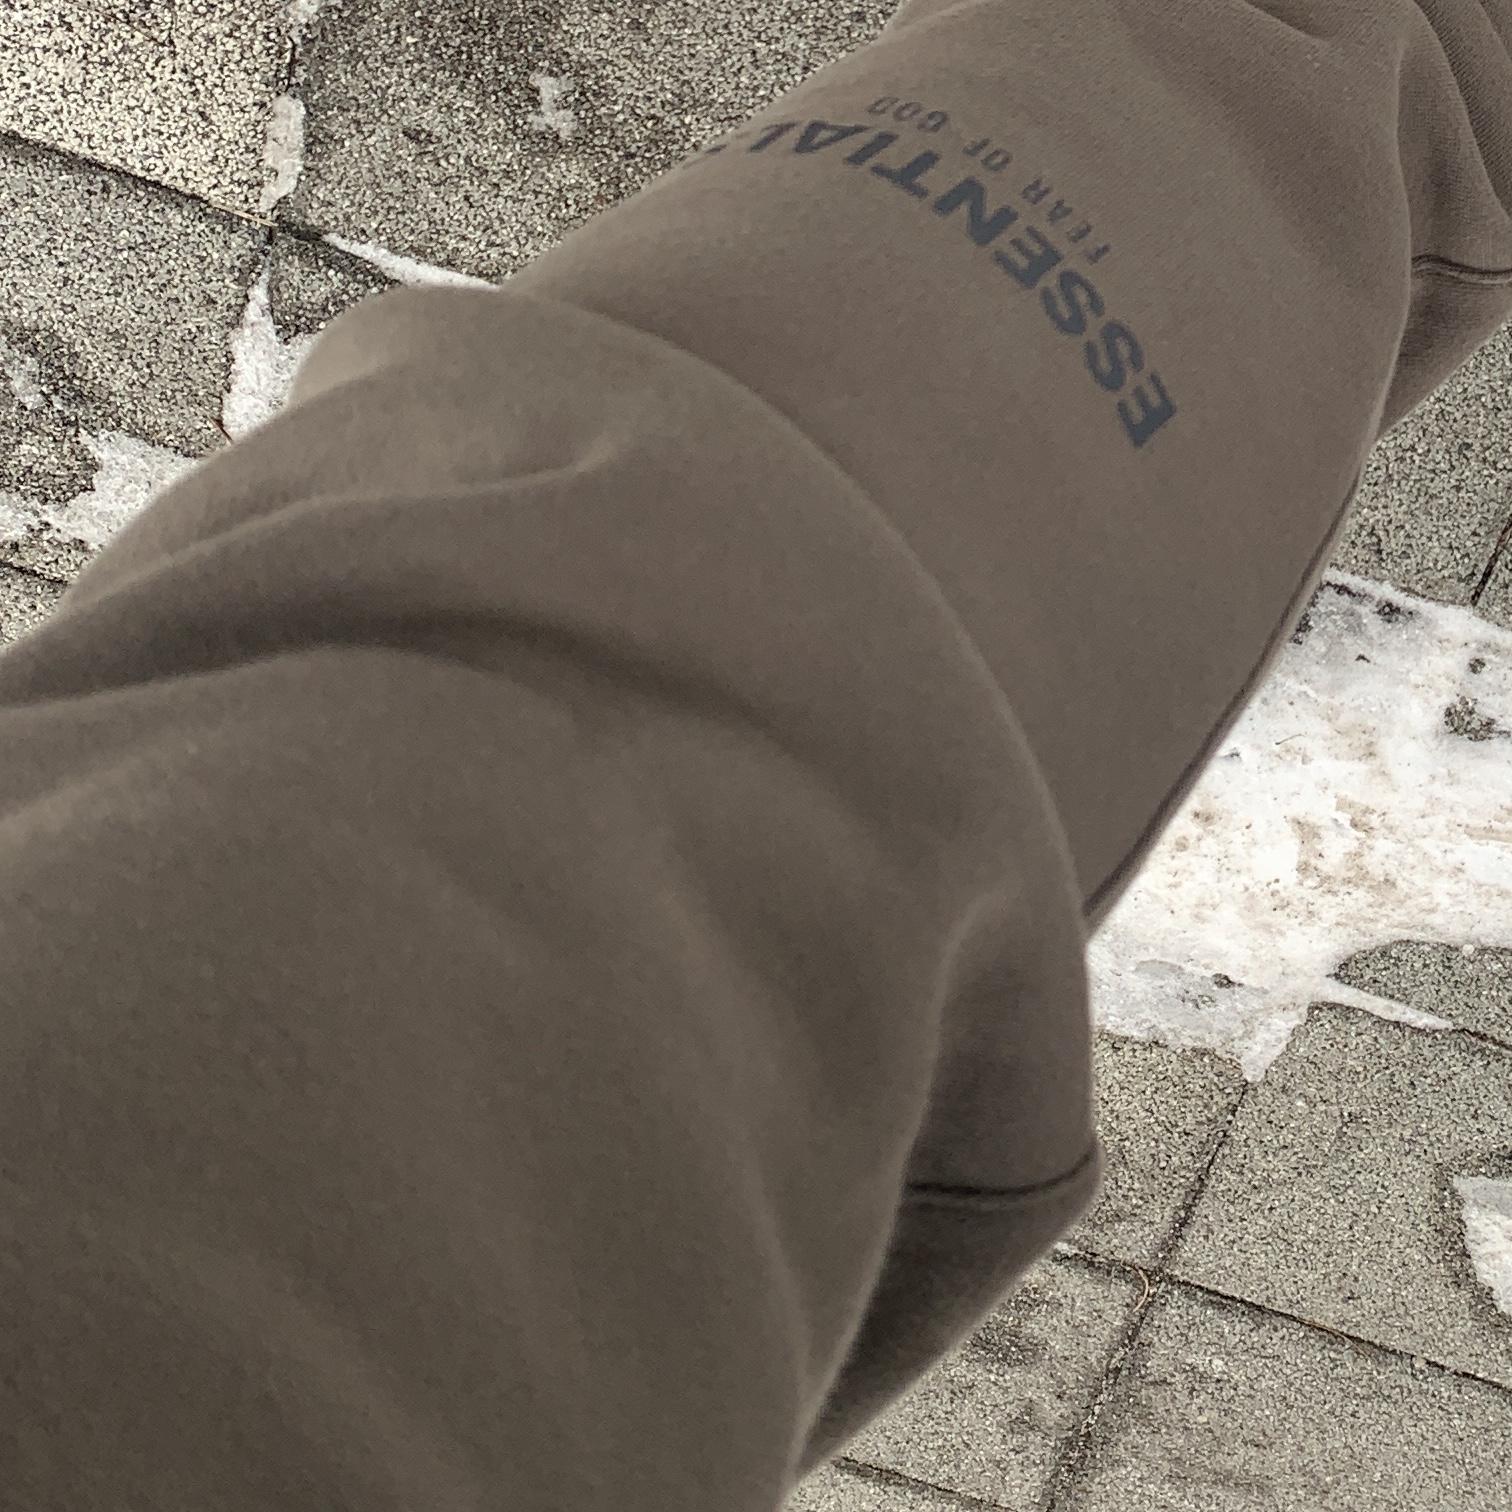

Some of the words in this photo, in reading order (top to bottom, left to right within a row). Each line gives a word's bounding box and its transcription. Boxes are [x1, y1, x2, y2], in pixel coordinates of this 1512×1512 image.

[867, 96, 950, 135] GOD
[963, 138, 1014, 172] OF
[1021, 178, 1112, 264] FEAR
[705, 119, 1177, 449] ESSENTIAL
